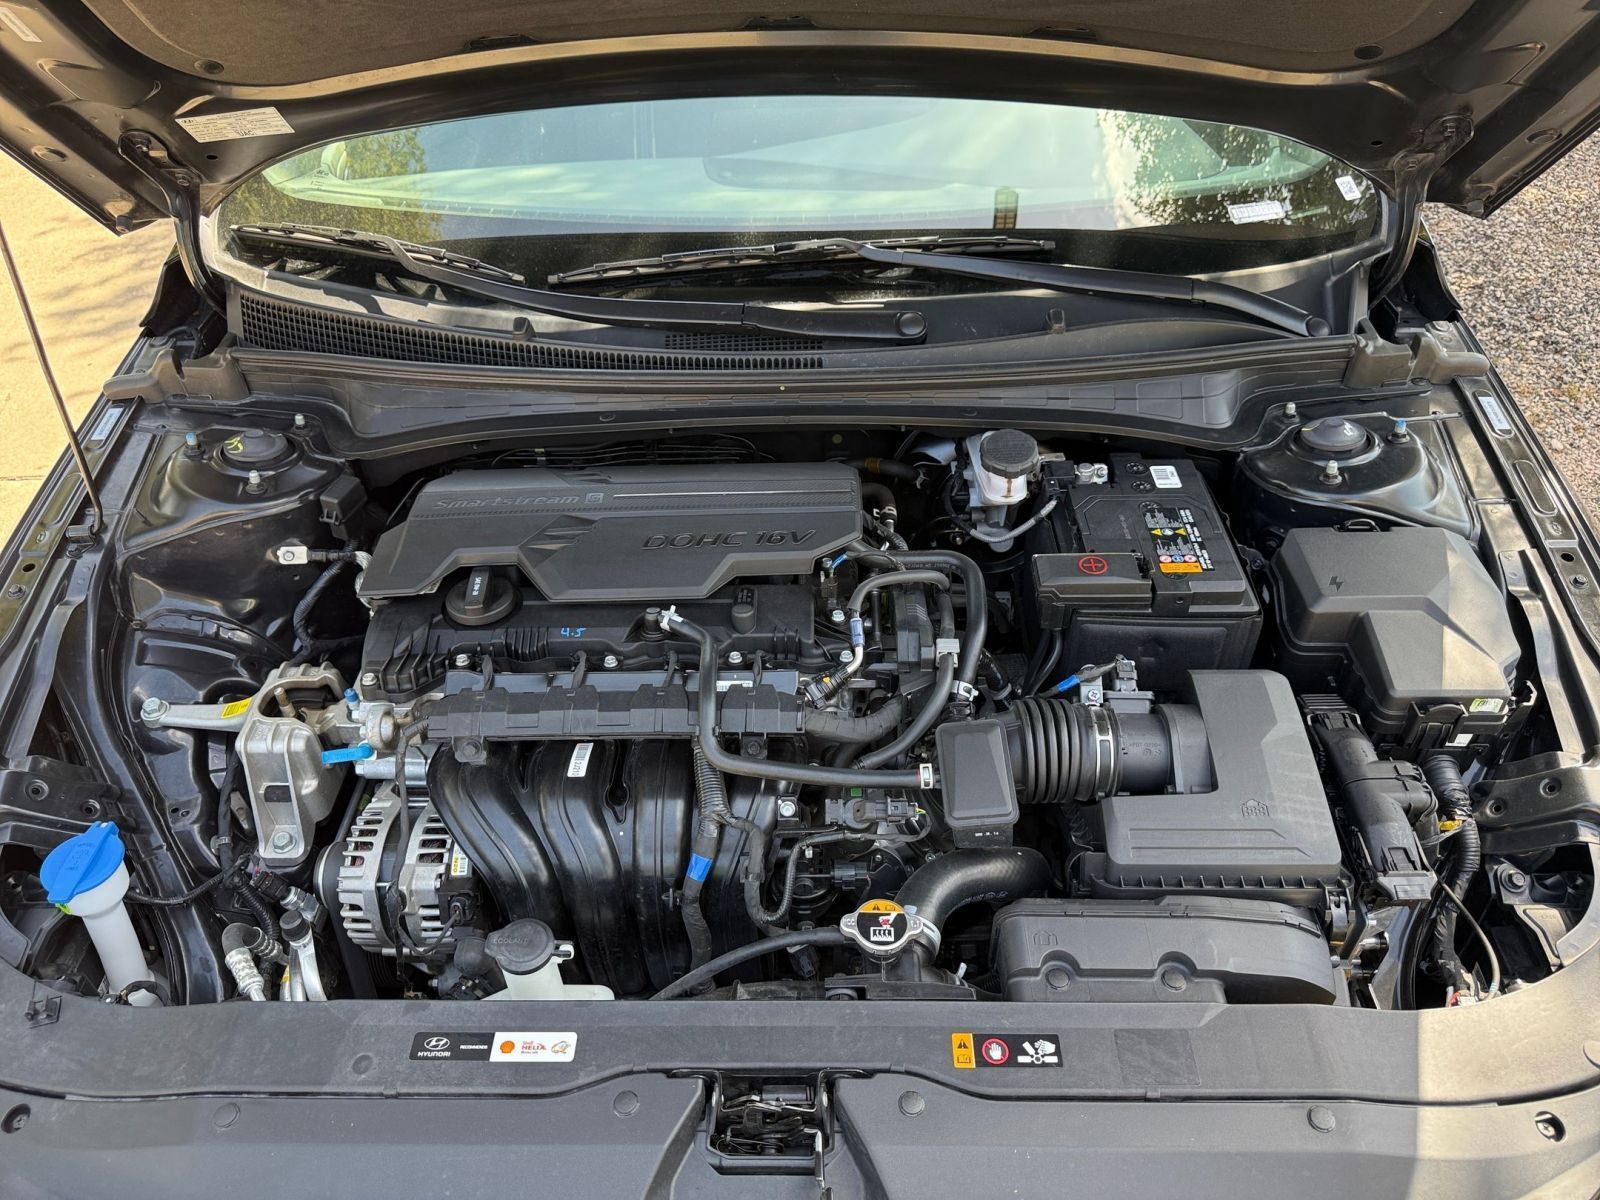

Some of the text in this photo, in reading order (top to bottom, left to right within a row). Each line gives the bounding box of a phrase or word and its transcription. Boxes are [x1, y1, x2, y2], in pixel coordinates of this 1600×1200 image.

[432, 494, 580, 509] Smartstream
[641, 529, 817, 551] DOHC 16V
[560, 627, 587, 638] 4.5
